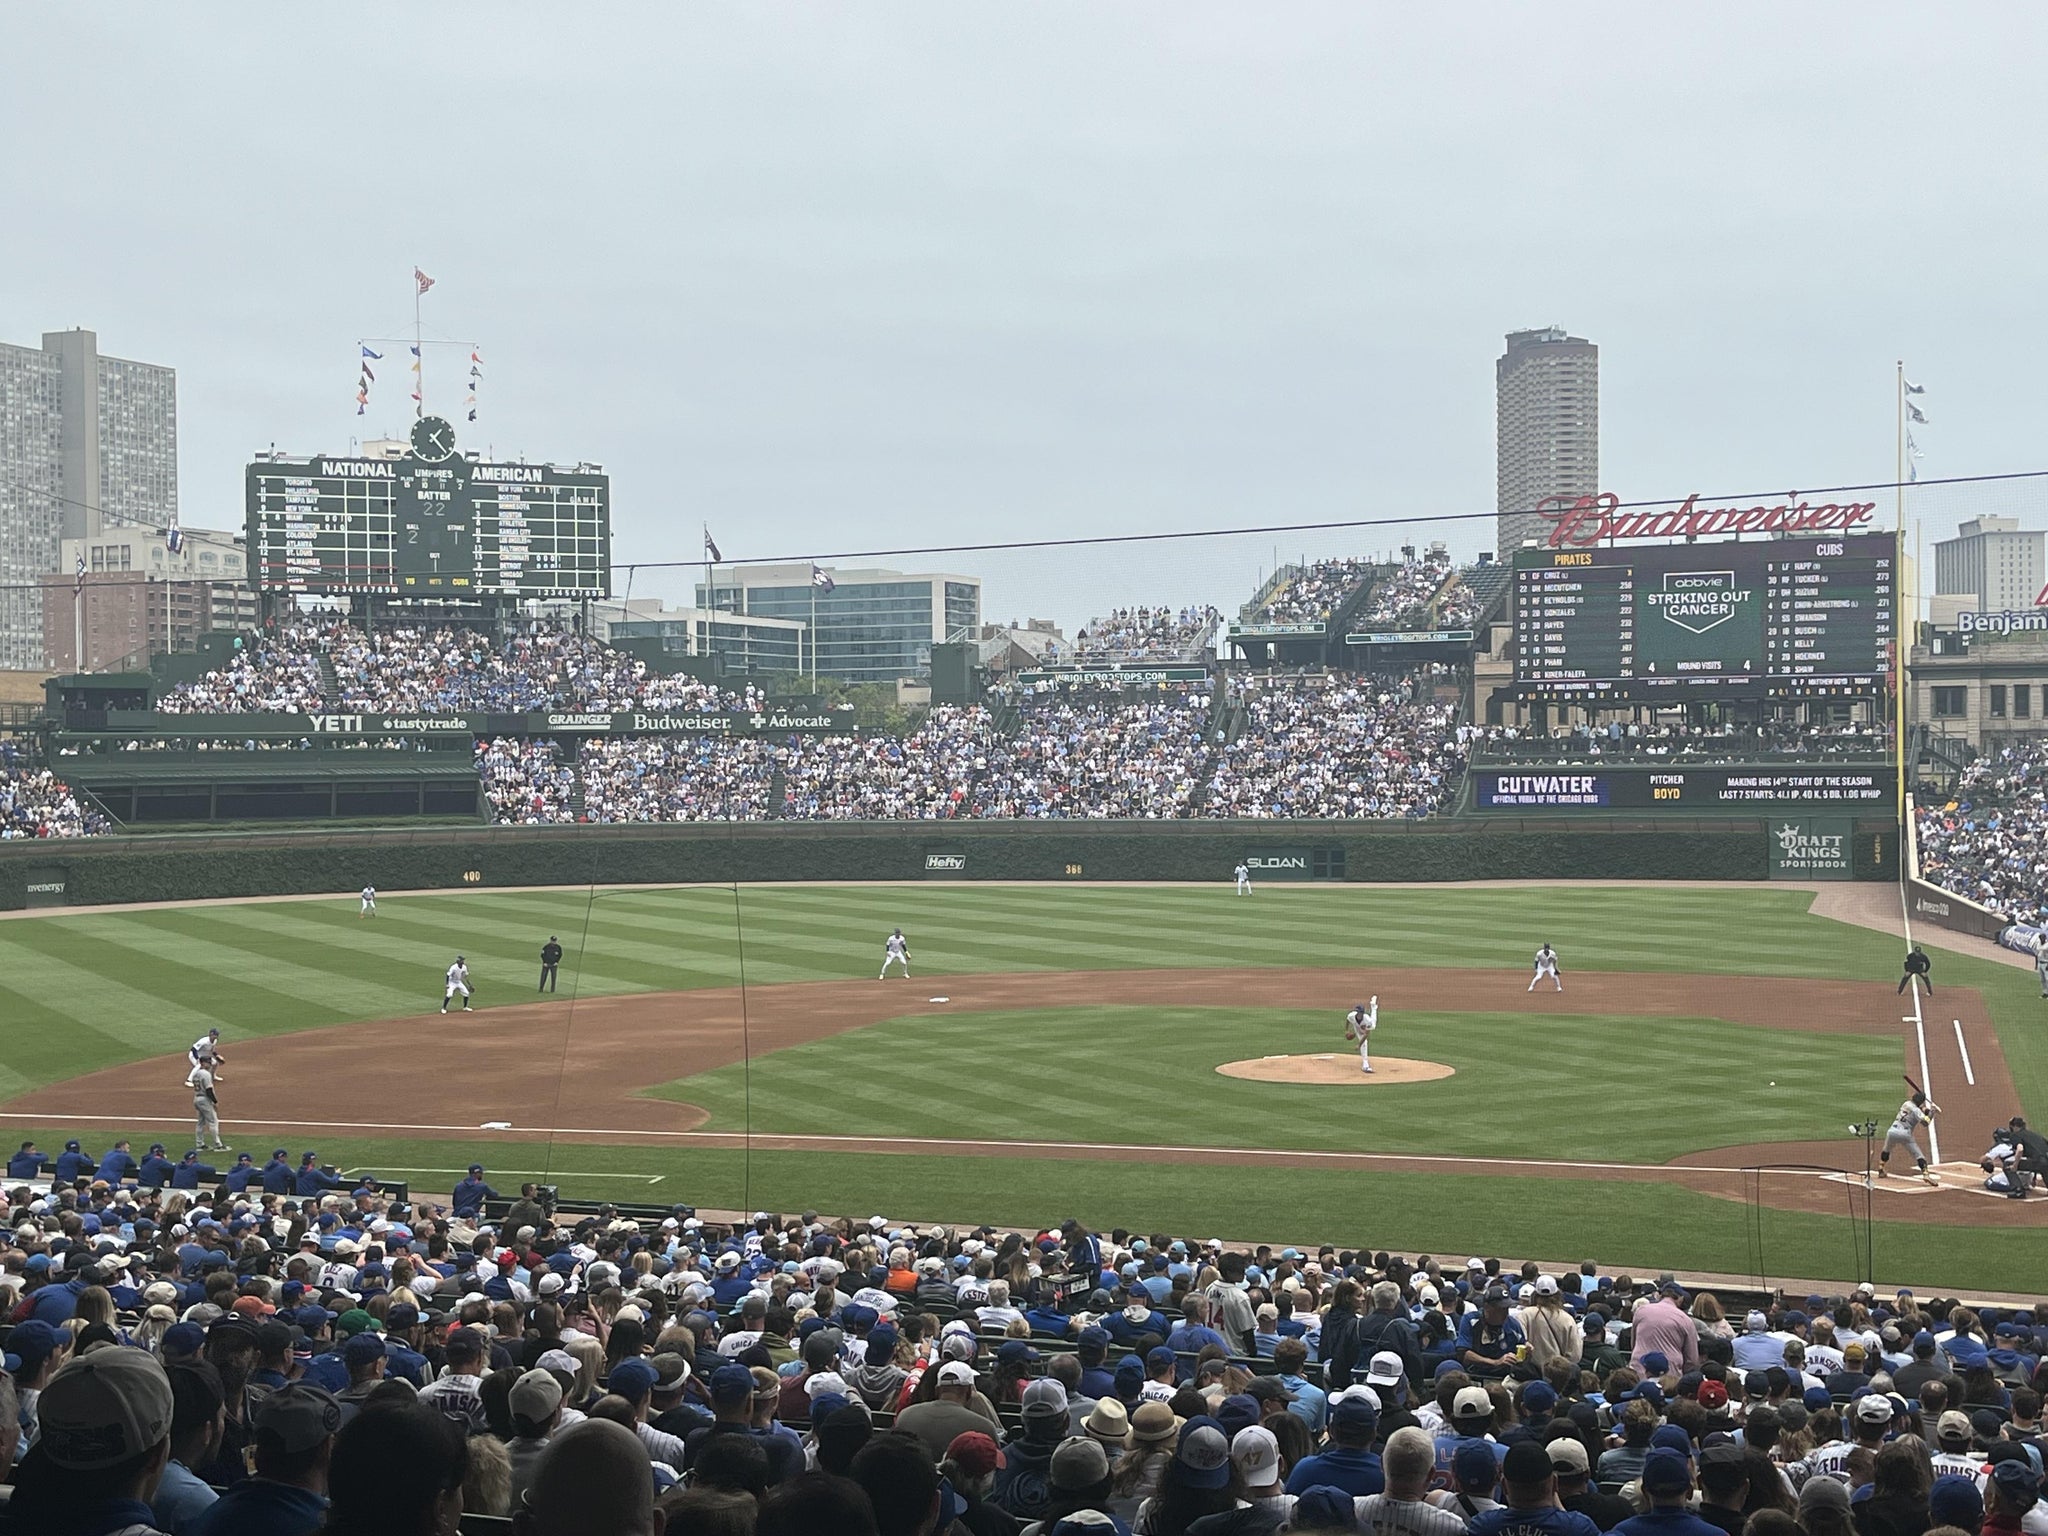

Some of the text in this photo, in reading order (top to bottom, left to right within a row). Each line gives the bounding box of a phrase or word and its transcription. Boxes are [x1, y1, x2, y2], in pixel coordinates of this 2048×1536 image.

[322, 461, 396, 478] NATIONAL
[414, 468, 454, 478] UMPIRES
[472, 466, 542, 482] AMERICAN
[417, 490, 451, 500] BATTER
[423, 501, 446, 516] 22
[1536, 492, 1876, 548] Budweiser
[286, 531, 318, 540] COLORADO
[408, 530, 418, 544] 2
[286, 540, 313, 548] ATLANTA
[1816, 544, 1844, 556] CUBS
[1554, 553, 1592, 566] PIRATES
[1782, 563, 1790, 571] LF
[1675, 578, 1723, 588] abbvie
[1795, 575, 1820, 583] TUCKER
[1648, 591, 1751, 605] STRIKING OUT
[1768, 589, 1776, 597] 27
[1544, 596, 1576, 604] REYNOLDS
[1544, 609, 1576, 617] GONZALES
[1670, 604, 1728, 616] CANCER
[1782, 614, 1790, 622] SS
[1544, 621, 1564, 629] HAYES
[1544, 633, 1563, 642] DAVIS
[1795, 640, 1815, 648] KELLY
[1532, 659, 1540, 667] LF
[1648, 660, 1751, 672] 4 MOUND VISITS 4
[1532, 671, 1541, 679] SS
[1795, 666, 1814, 674] SHAW
[308, 714, 467, 732] YETI tastytrade
[548, 714, 612, 724] GRAINGER
[769, 715, 832, 727] Advocate
[1498, 776, 1594, 794] CUTWATER
[1650, 775, 1684, 785] PITCHER
[1728, 777, 1757, 786] MAKING
[1758, 777, 1772, 786] HIS
[1788, 777, 1813, 786] START
[1814, 777, 1824, 786] OF
[1824, 776, 1840, 786] THE
[1841, 776, 1872, 786] SEASON
[1654, 788, 1680, 800] BOYD
[1719, 790, 1738, 799] LAST
[1738, 790, 1744, 799] 7
[1744, 790, 1776, 799] STARTS:
[1823, 790, 1828, 799] 5
[1860, 790, 1881, 799] WHIP
[1492, 795, 1517, 804] OFFICIAL
[1558, 795, 1582, 803] CHICAGO
[1780, 835, 1844, 850] DRAFT
[1786, 848, 1842, 859] KINGS
[928, 856, 964, 868] Hefty
[1246, 857, 1304, 868] SLOAN
[1780, 860, 1847, 868] SPORTSBOOK
[463, 871, 480, 882] 400
